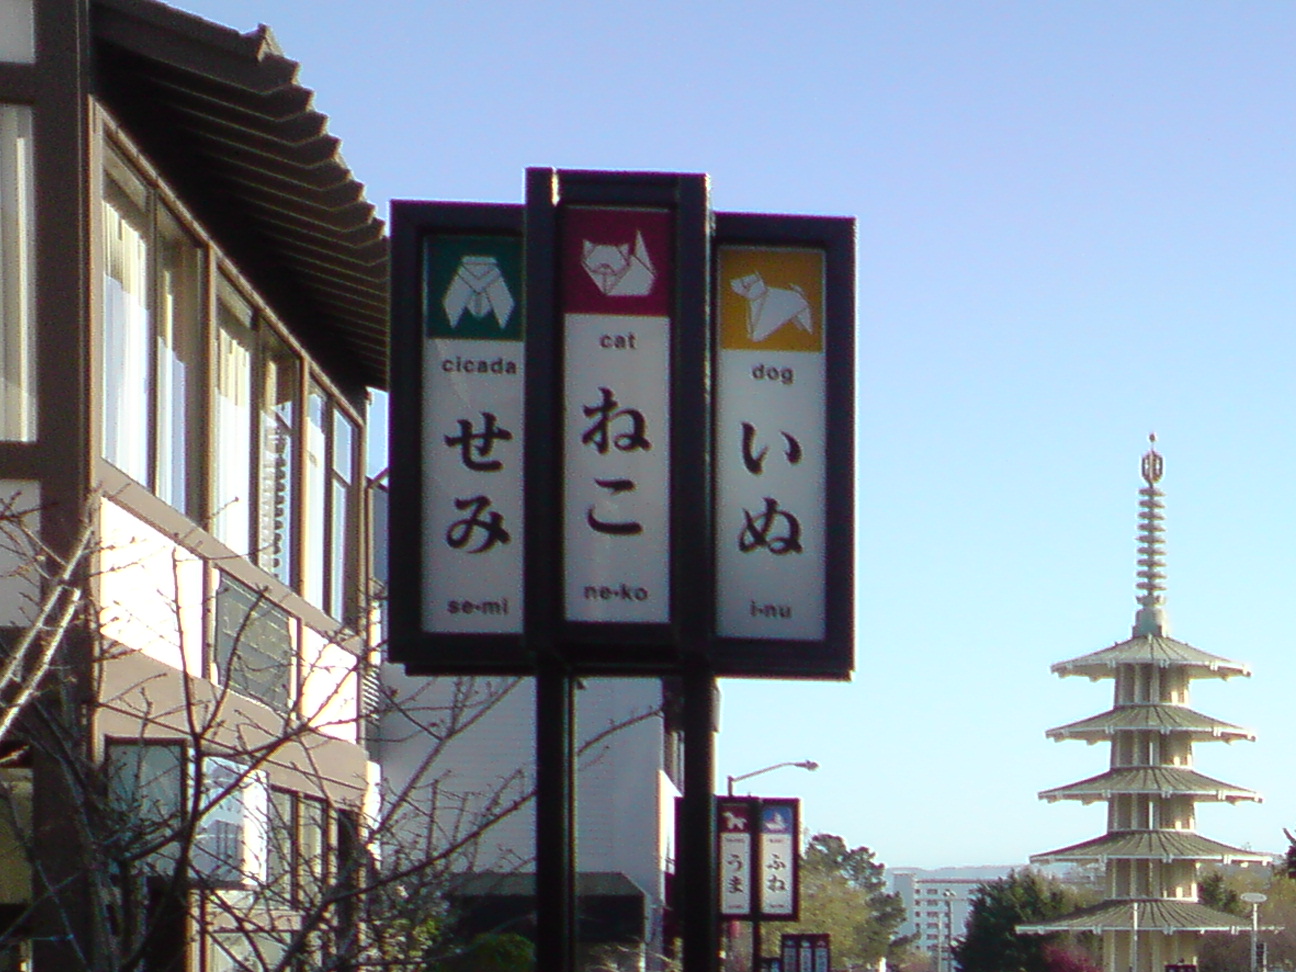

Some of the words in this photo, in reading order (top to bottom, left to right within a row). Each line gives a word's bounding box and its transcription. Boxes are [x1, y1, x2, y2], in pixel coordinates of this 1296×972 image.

[599, 331, 638, 350] cat
[441, 356, 518, 375] cicada
[751, 363, 795, 386] dog
[581, 386, 652, 536] ねこ
[443, 411, 513, 554] せみ
[738, 421, 804, 556] いぬ
[728, 854, 743, 893] うま
[766, 853, 787, 893] ふね
